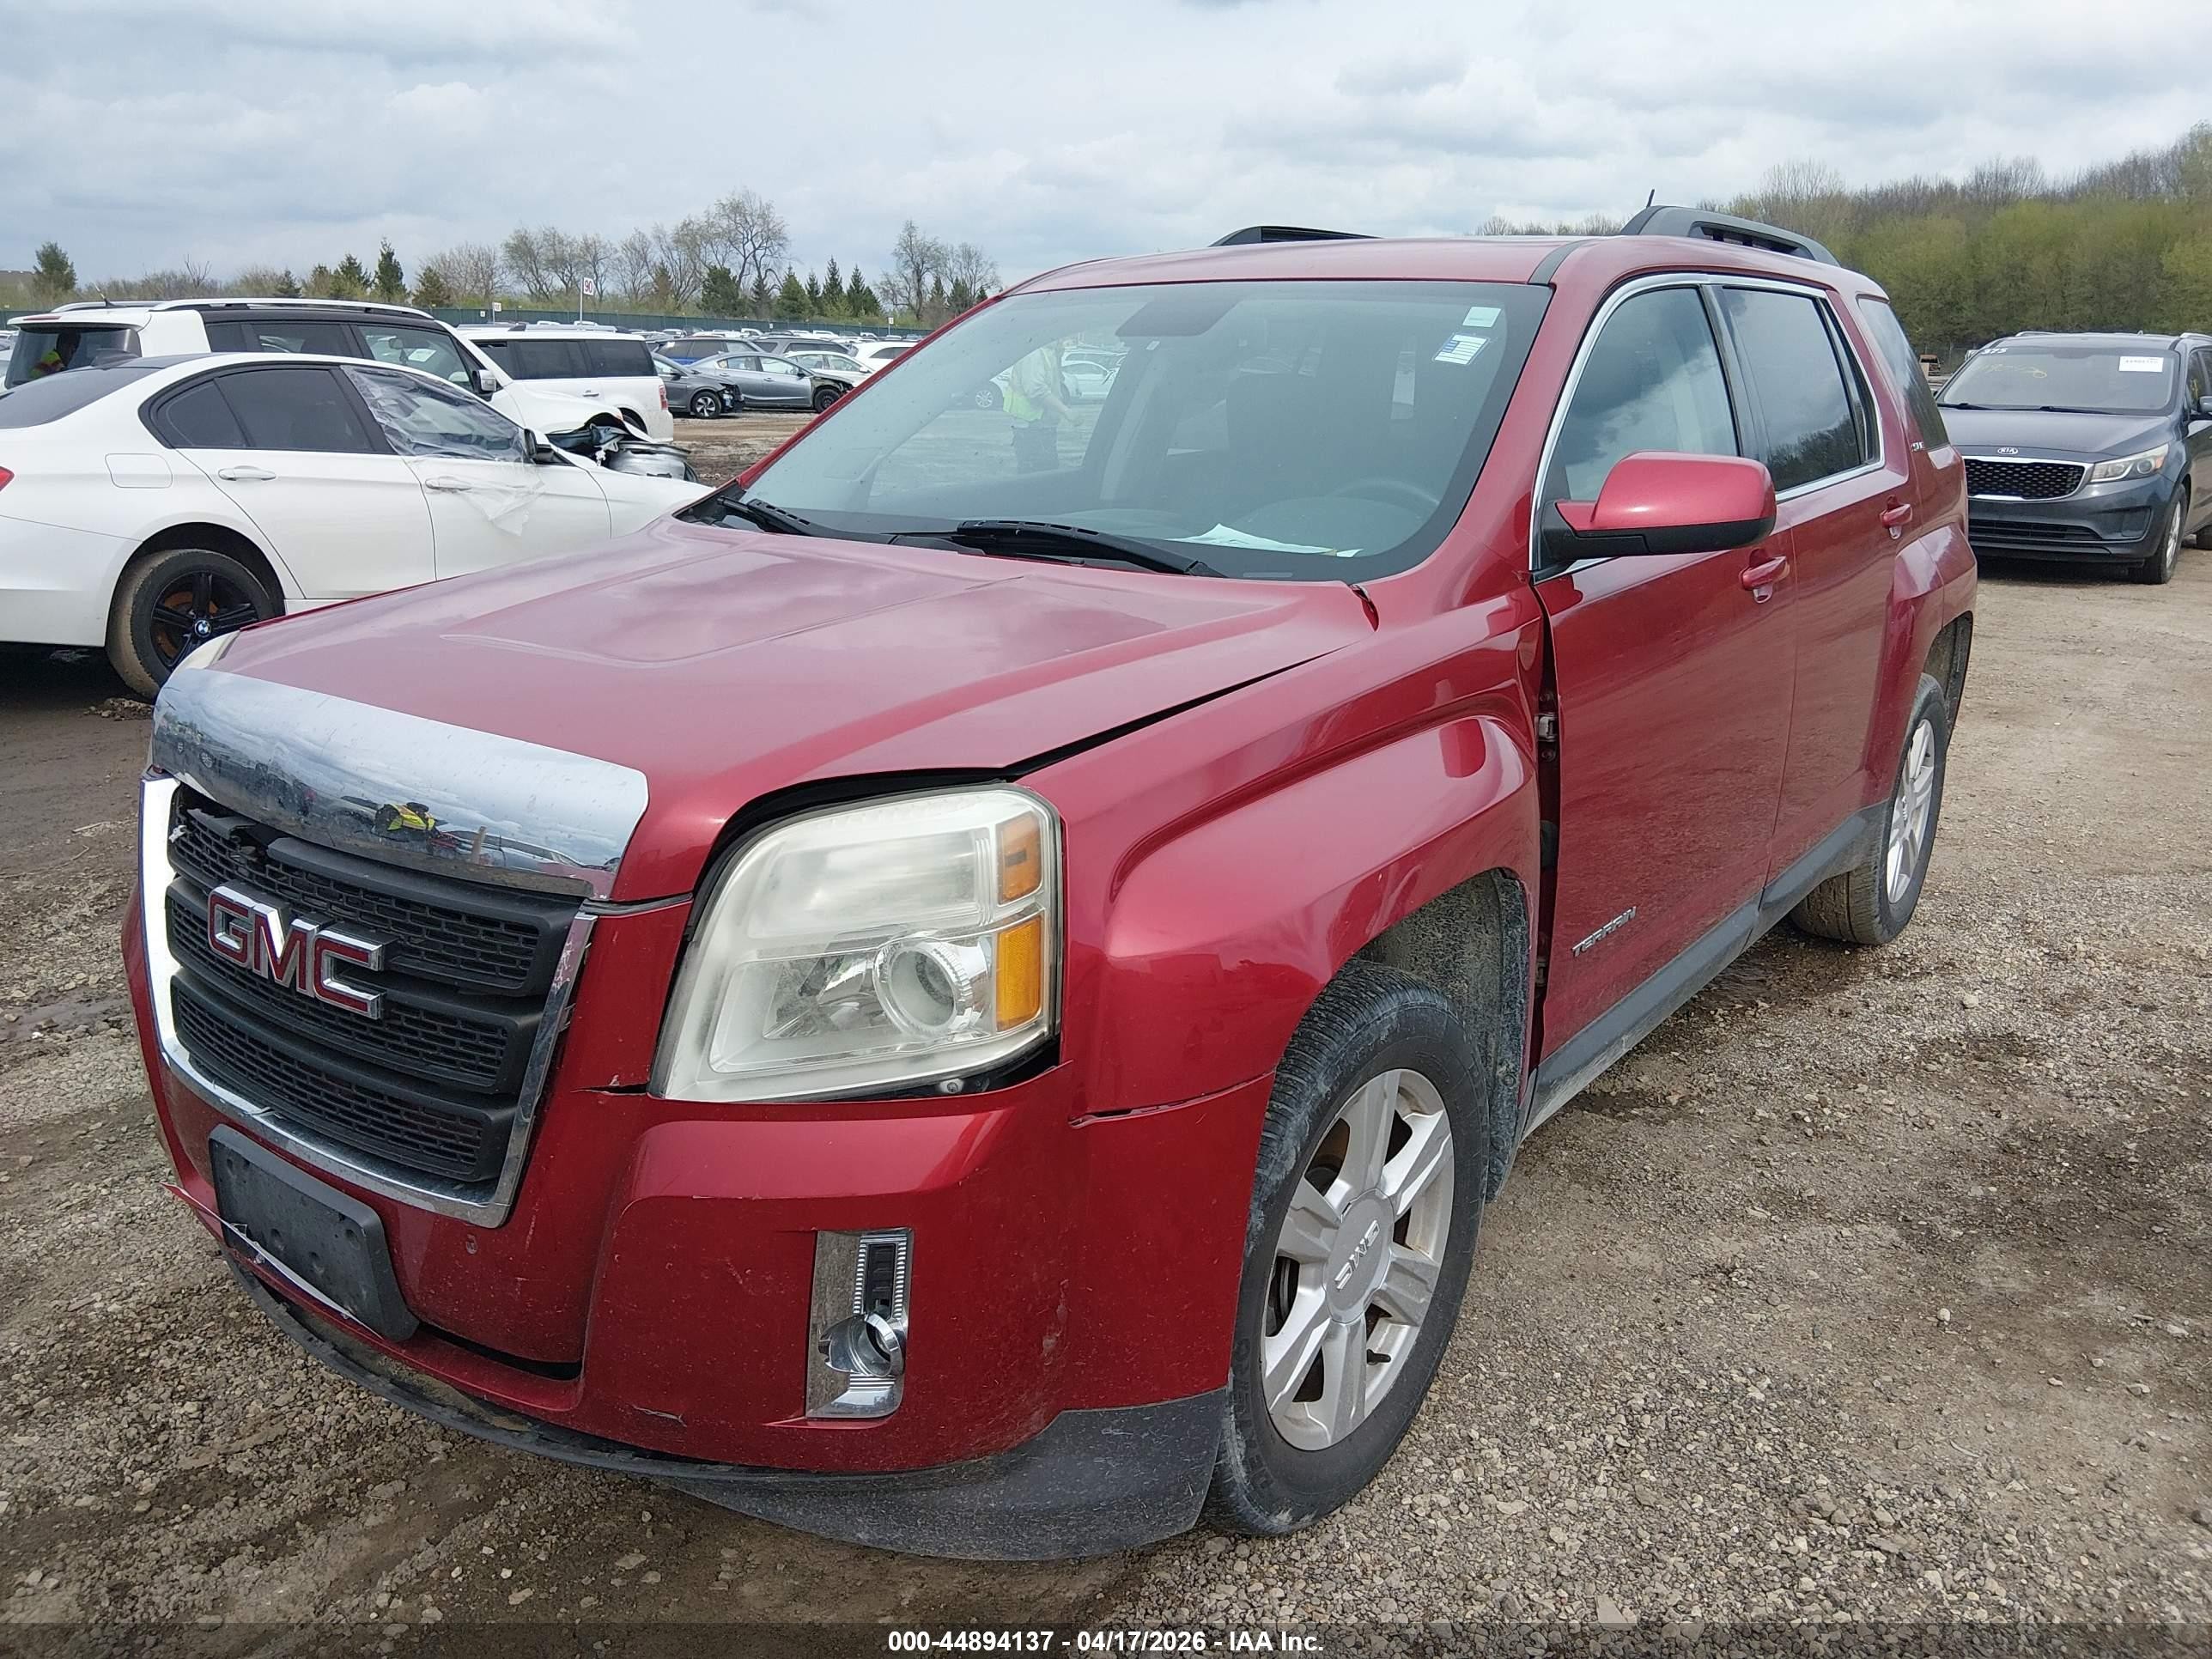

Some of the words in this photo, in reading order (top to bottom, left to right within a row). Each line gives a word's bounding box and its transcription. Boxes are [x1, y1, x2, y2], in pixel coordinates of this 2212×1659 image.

[585, 280, 593, 294] 90
[208, 886, 384, 1021] GMC
[1571, 906, 1637, 957] TERRAIN
[1334, 1219, 1380, 1290] GMC
